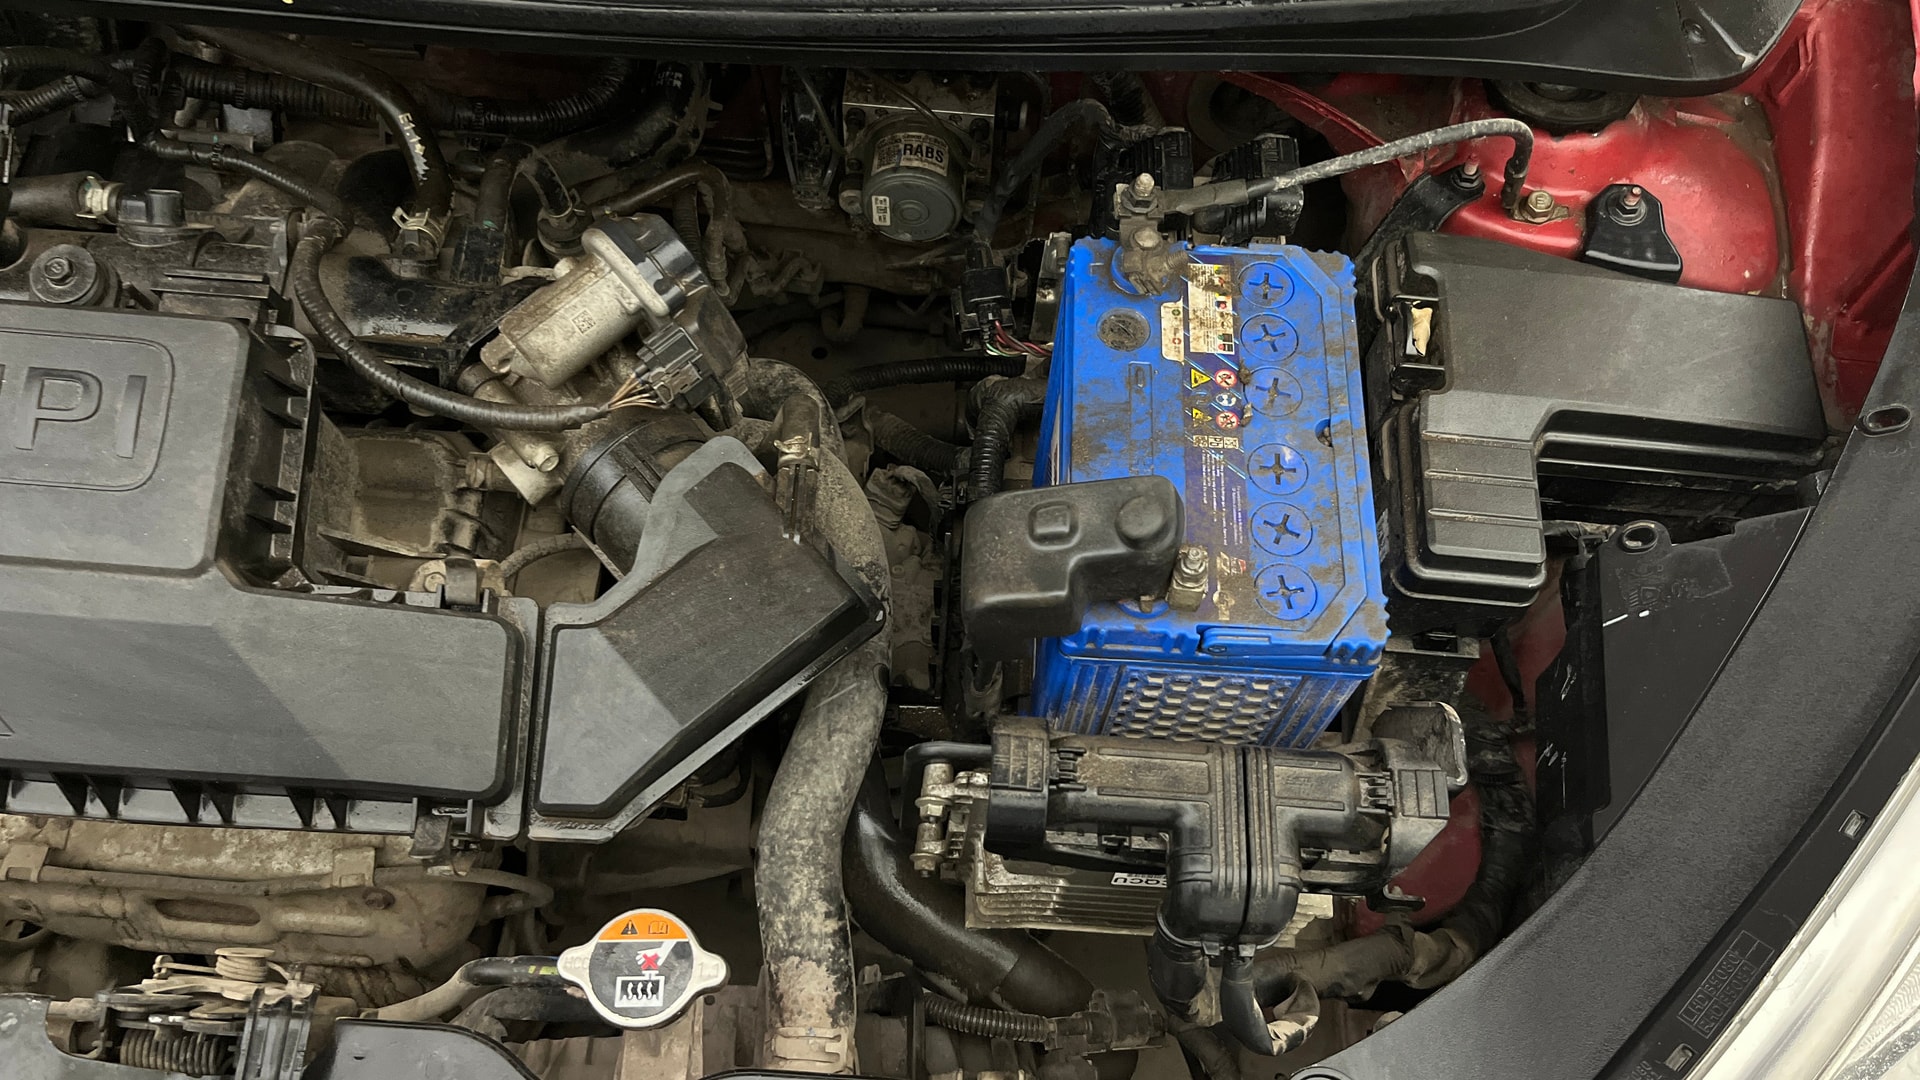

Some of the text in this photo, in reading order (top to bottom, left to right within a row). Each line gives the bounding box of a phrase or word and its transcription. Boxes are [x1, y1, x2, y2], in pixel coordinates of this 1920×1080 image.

[903, 144, 945, 164] RABS
[0, 364, 147, 459] PI
[1682, 994, 1709, 1022] LHD
